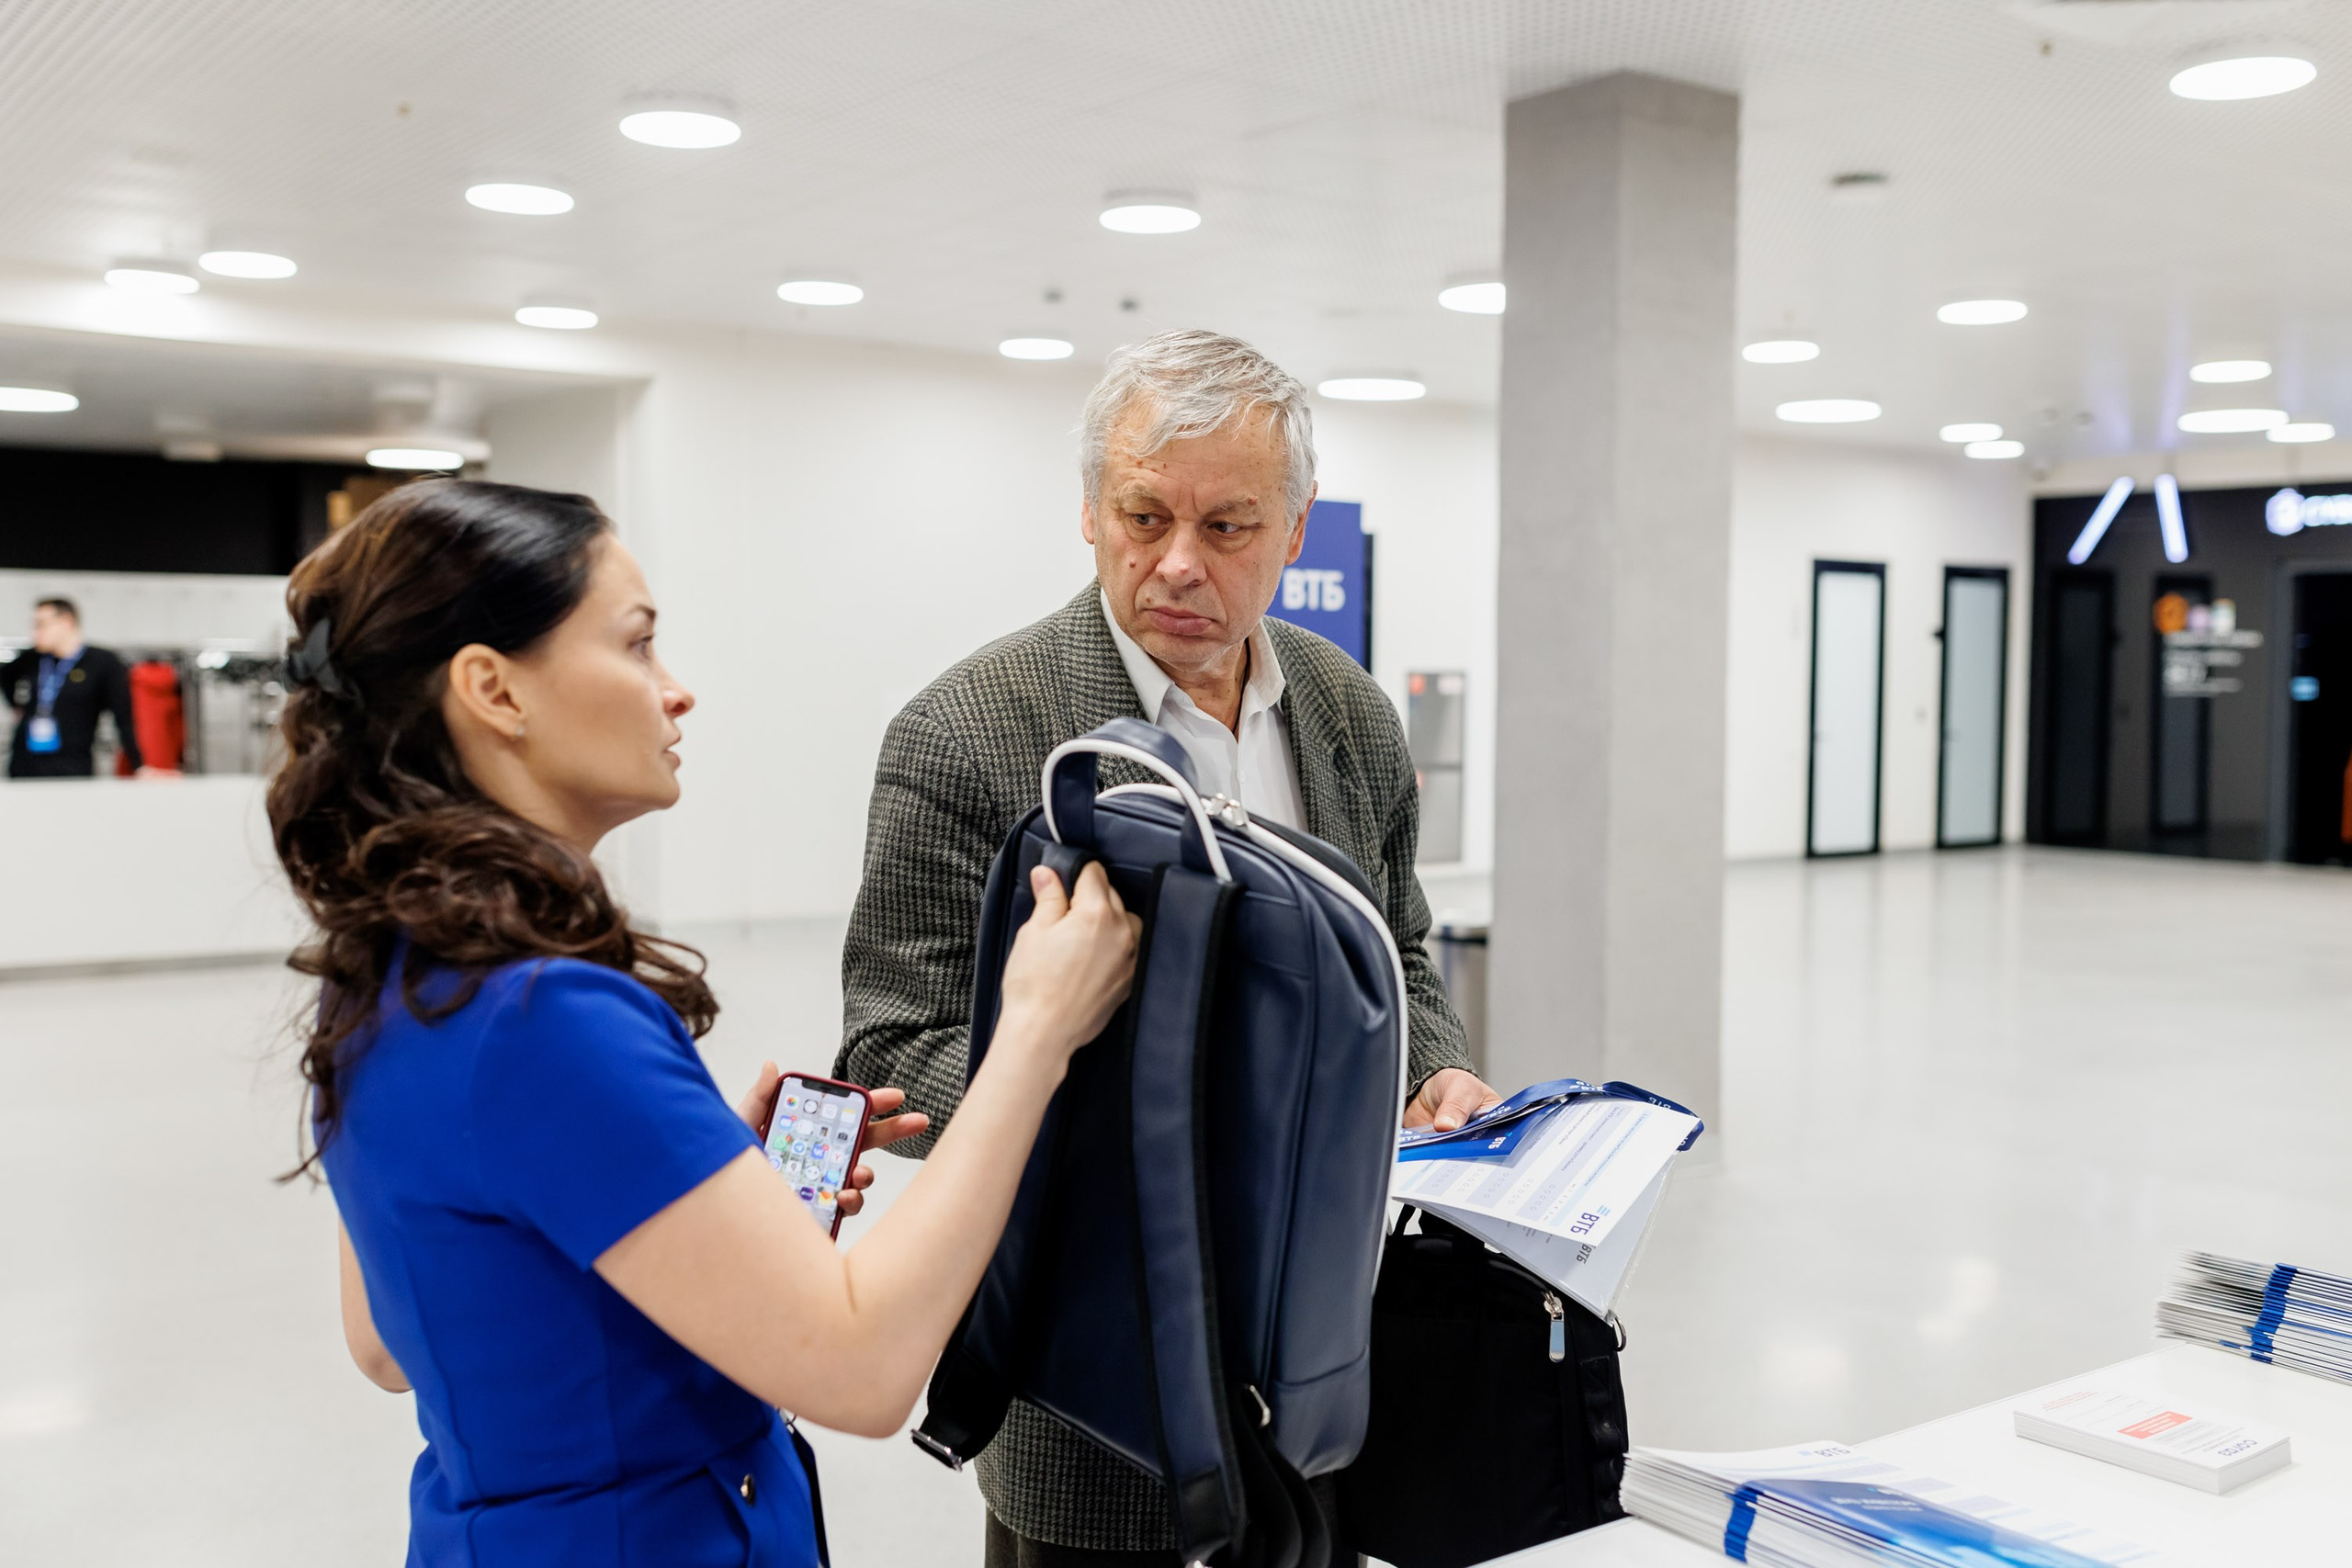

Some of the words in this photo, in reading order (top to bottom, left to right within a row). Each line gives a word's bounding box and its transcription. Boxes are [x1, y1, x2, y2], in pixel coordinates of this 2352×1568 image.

[1283, 568, 1346, 612] ВТБ
[1488, 1136, 1507, 1149] ВТБ
[1569, 1213, 1600, 1235] ВТБ
[1576, 1244, 1592, 1264] ВТБ
